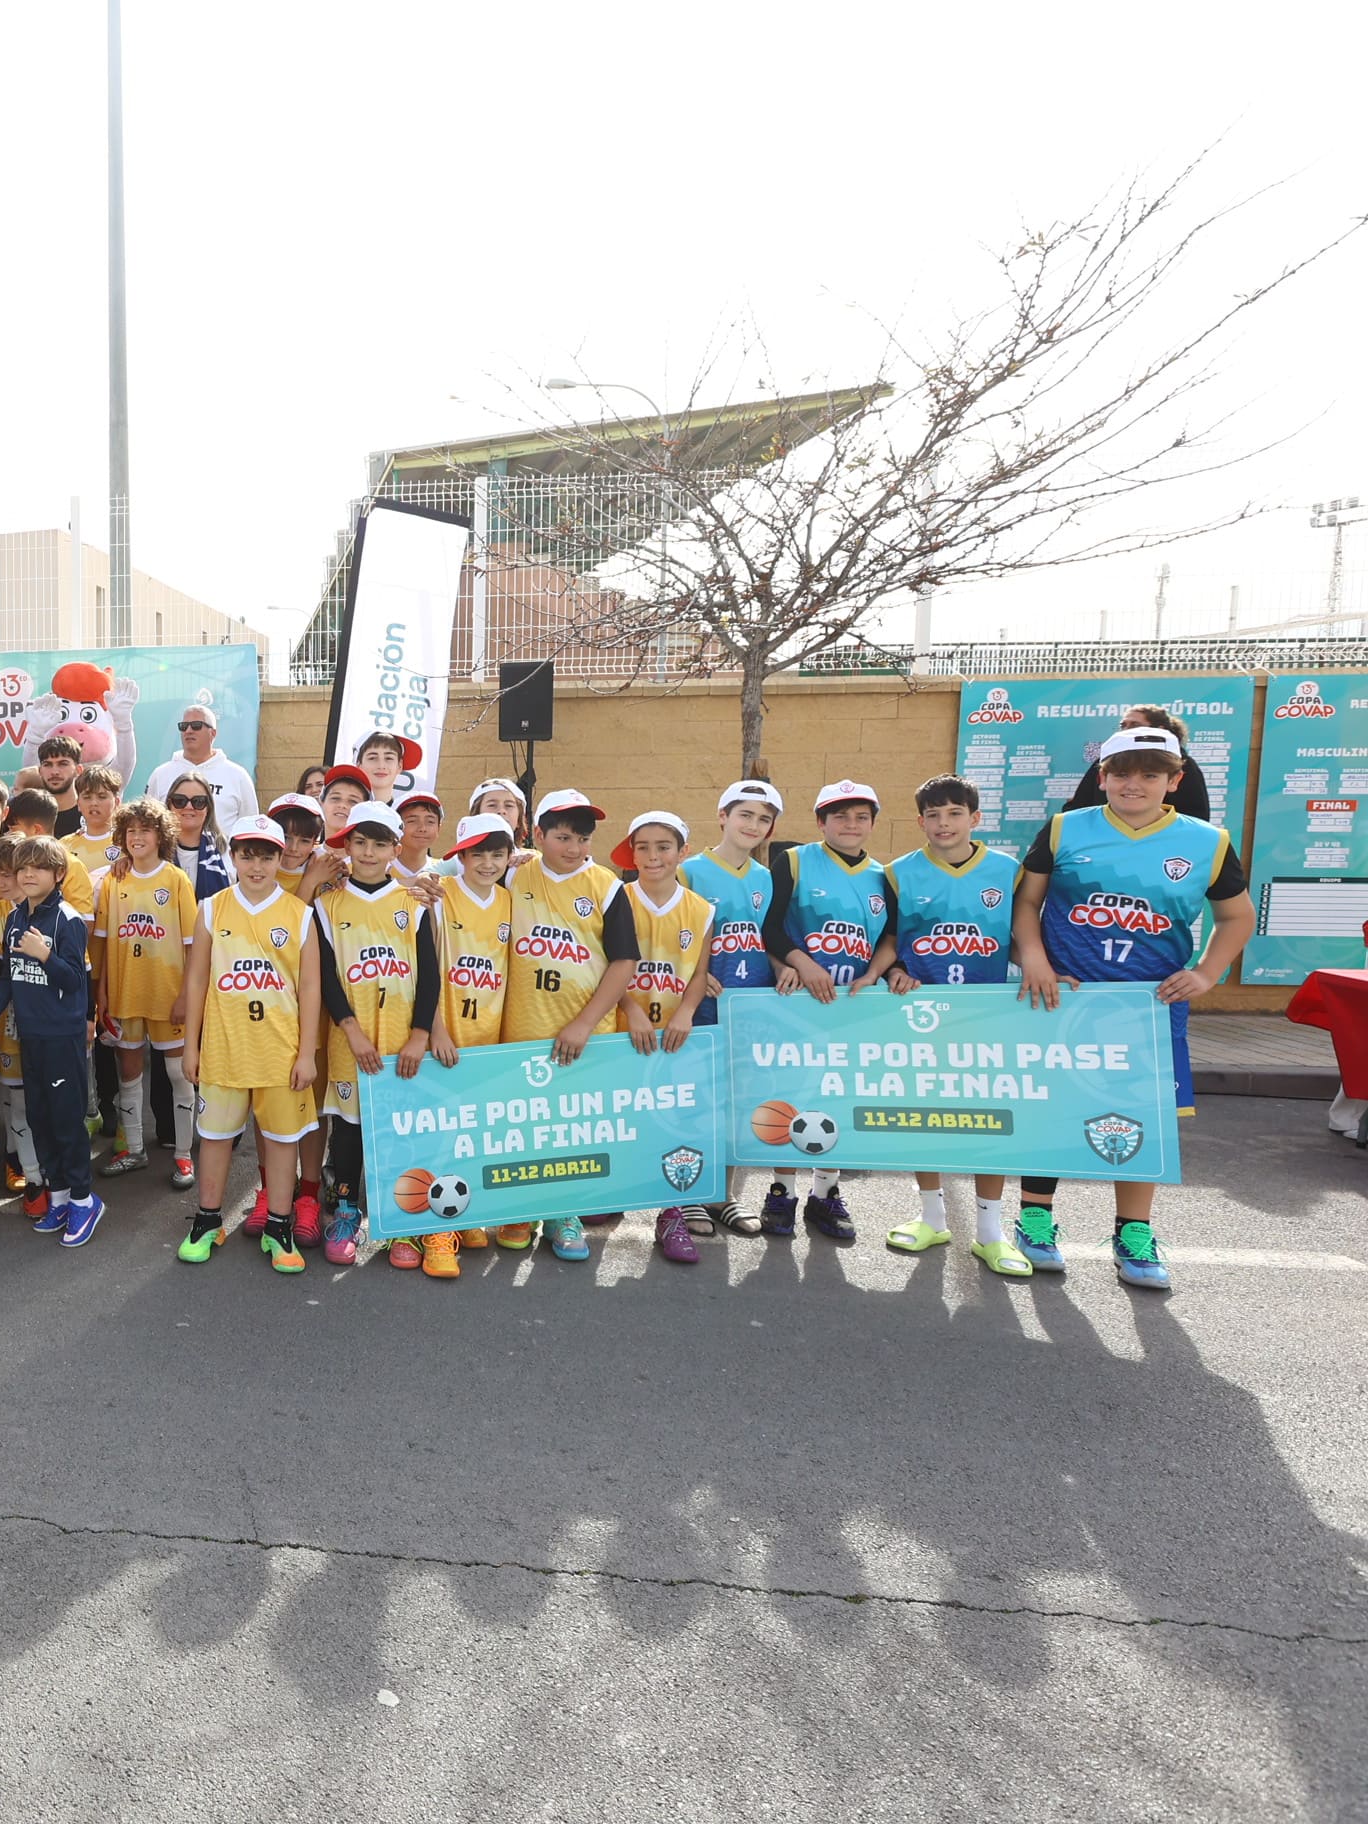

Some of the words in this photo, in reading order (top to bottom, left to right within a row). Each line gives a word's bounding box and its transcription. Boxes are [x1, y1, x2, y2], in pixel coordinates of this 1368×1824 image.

[369, 622, 407, 731] dación
[981, 703, 1010, 711] COPA
[1289, 697, 1321, 705] COPA
[968, 711, 1023, 724] COVAP
[1275, 705, 1334, 718] COVAP
[1296, 748, 1368, 758] MASCULIN
[1312, 802, 1350, 810] FINAL
[1089, 894, 1148, 911] COPA
[127, 914, 154, 924] COPA
[1069, 905, 1171, 934] COVAP
[118, 923, 165, 940] COVAP
[532, 925, 573, 942] COPA
[723, 923, 757, 934] COPA
[824, 923, 865, 939] COPA
[933, 925, 979, 936] COPA
[133, 943, 142, 957] 8
[360, 946, 395, 961] COPA
[515, 937, 590, 964] COVAP
[912, 936, 998, 956] COVAP
[1101, 938, 1134, 963] 17
[233, 960, 274, 971] COPA
[347, 959, 410, 983] COVAP
[458, 956, 493, 971] COPA
[638, 962, 673, 974] COPA
[735, 960, 748, 979] 4
[534, 968, 561, 992] 16
[828, 965, 855, 985] 10
[947, 964, 965, 984] 8
[249, 1000, 264, 1021] 9
[461, 998, 478, 1019] 11
[649, 1002, 662, 1023] 8
[752, 1043, 849, 1067] VALE
[859, 1043, 937, 1067] POR
[948, 1043, 1004, 1068] UN
[1016, 1044, 1130, 1070] PASE
[820, 1072, 845, 1096] A
[855, 1072, 905, 1096] LA
[915, 1073, 1049, 1100] FINAL
[392, 1104, 478, 1135] VALE
[486, 1097, 550, 1125] POR
[559, 1091, 603, 1118] UN
[613, 1083, 696, 1113] PASE
[864, 1111, 922, 1127] 11-12
[927, 1113, 1002, 1129] ABRIL
[1096, 1125, 1132, 1133] COVAP
[454, 1134, 475, 1158] A
[483, 1129, 525, 1155] LA
[533, 1118, 636, 1150] FINAL
[491, 1165, 539, 1183] 11-12
[543, 1160, 601, 1177] ABRIL
